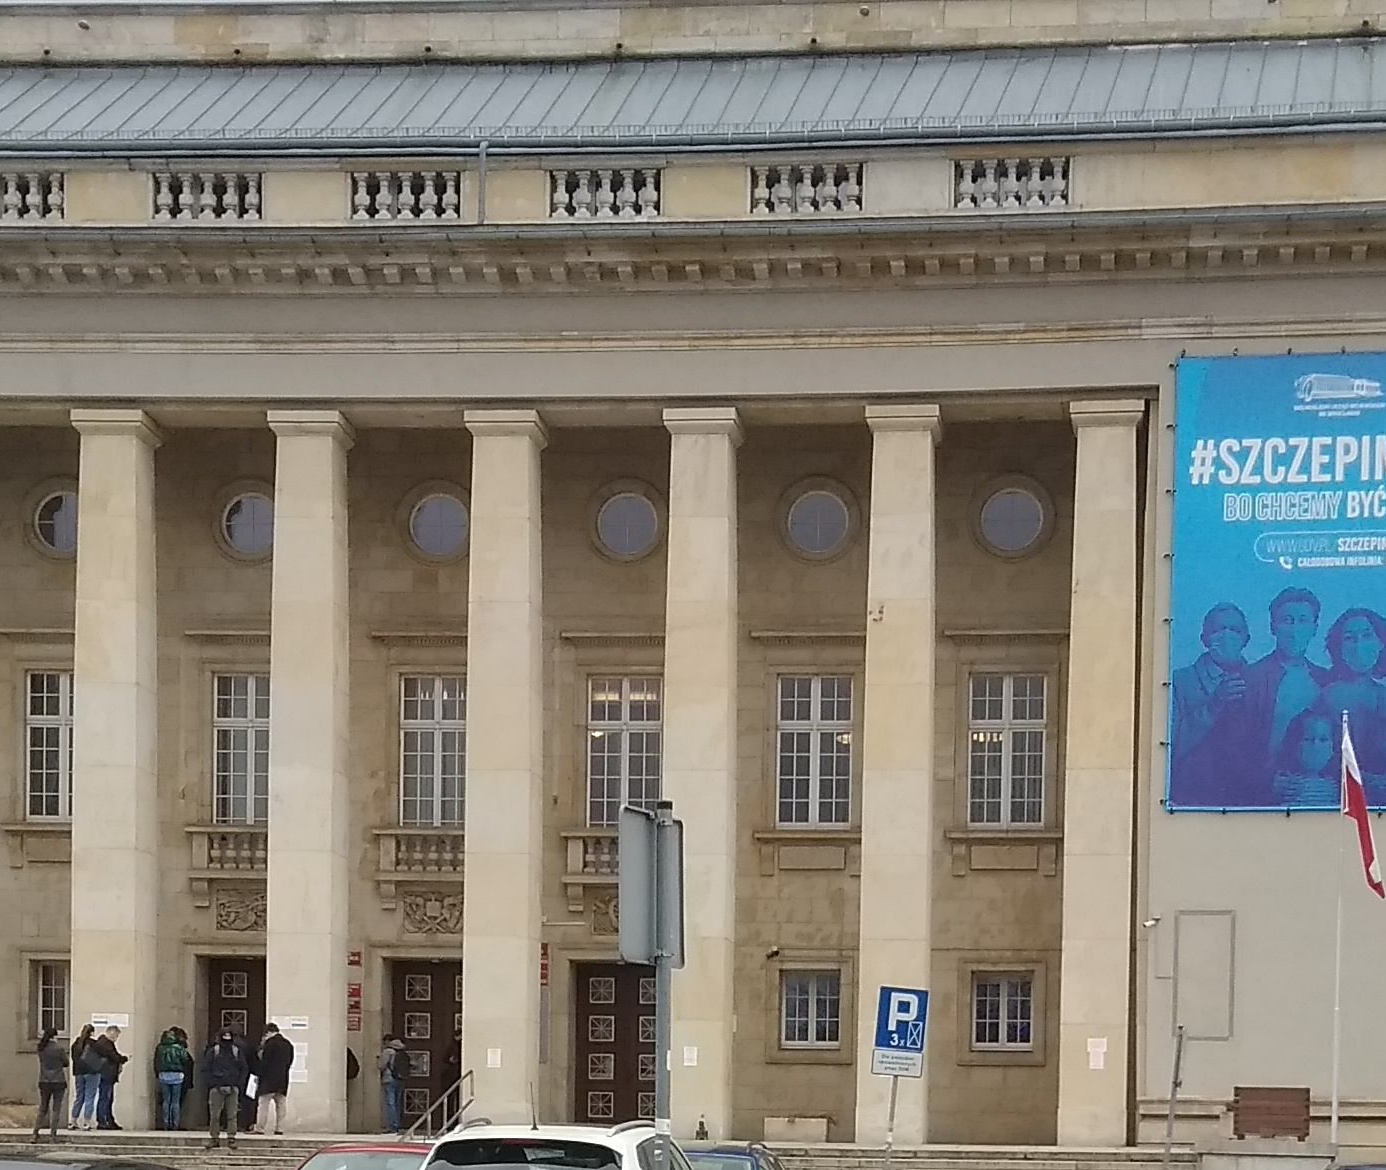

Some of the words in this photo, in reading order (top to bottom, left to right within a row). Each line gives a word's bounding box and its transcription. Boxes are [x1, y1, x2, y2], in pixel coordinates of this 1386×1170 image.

[1223, 492, 1253, 522] BO
[1255, 489, 1343, 521] CHCEMY
[1346, 484, 1386, 519] BYĆ
[888, 992, 919, 1031] P
